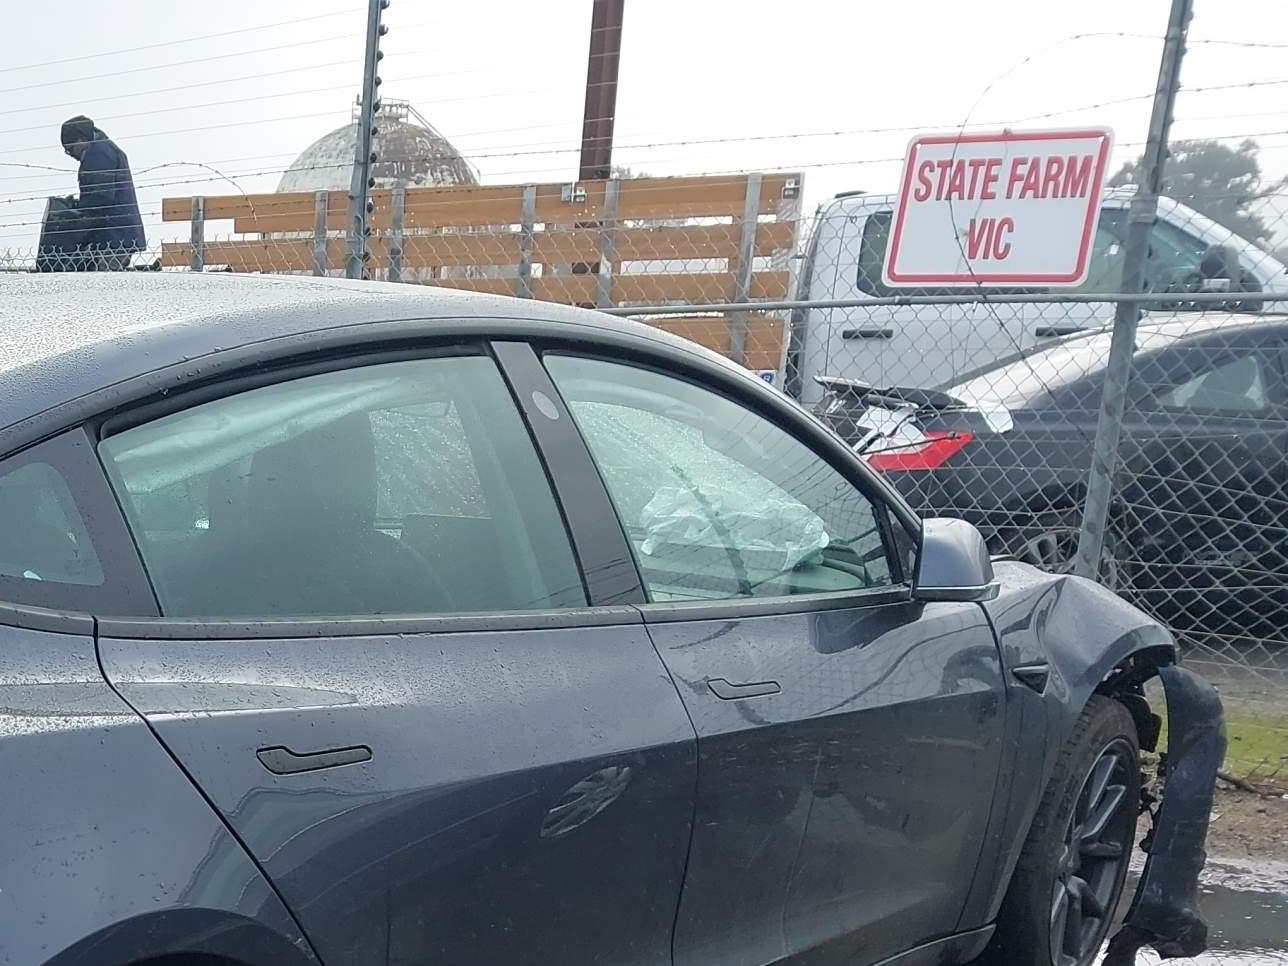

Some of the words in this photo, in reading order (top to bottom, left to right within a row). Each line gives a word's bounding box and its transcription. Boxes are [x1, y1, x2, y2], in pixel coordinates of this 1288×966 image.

[913, 157, 1003, 203] STATE
[1005, 154, 1094, 199] FARM
[967, 216, 1015, 261] VIC
